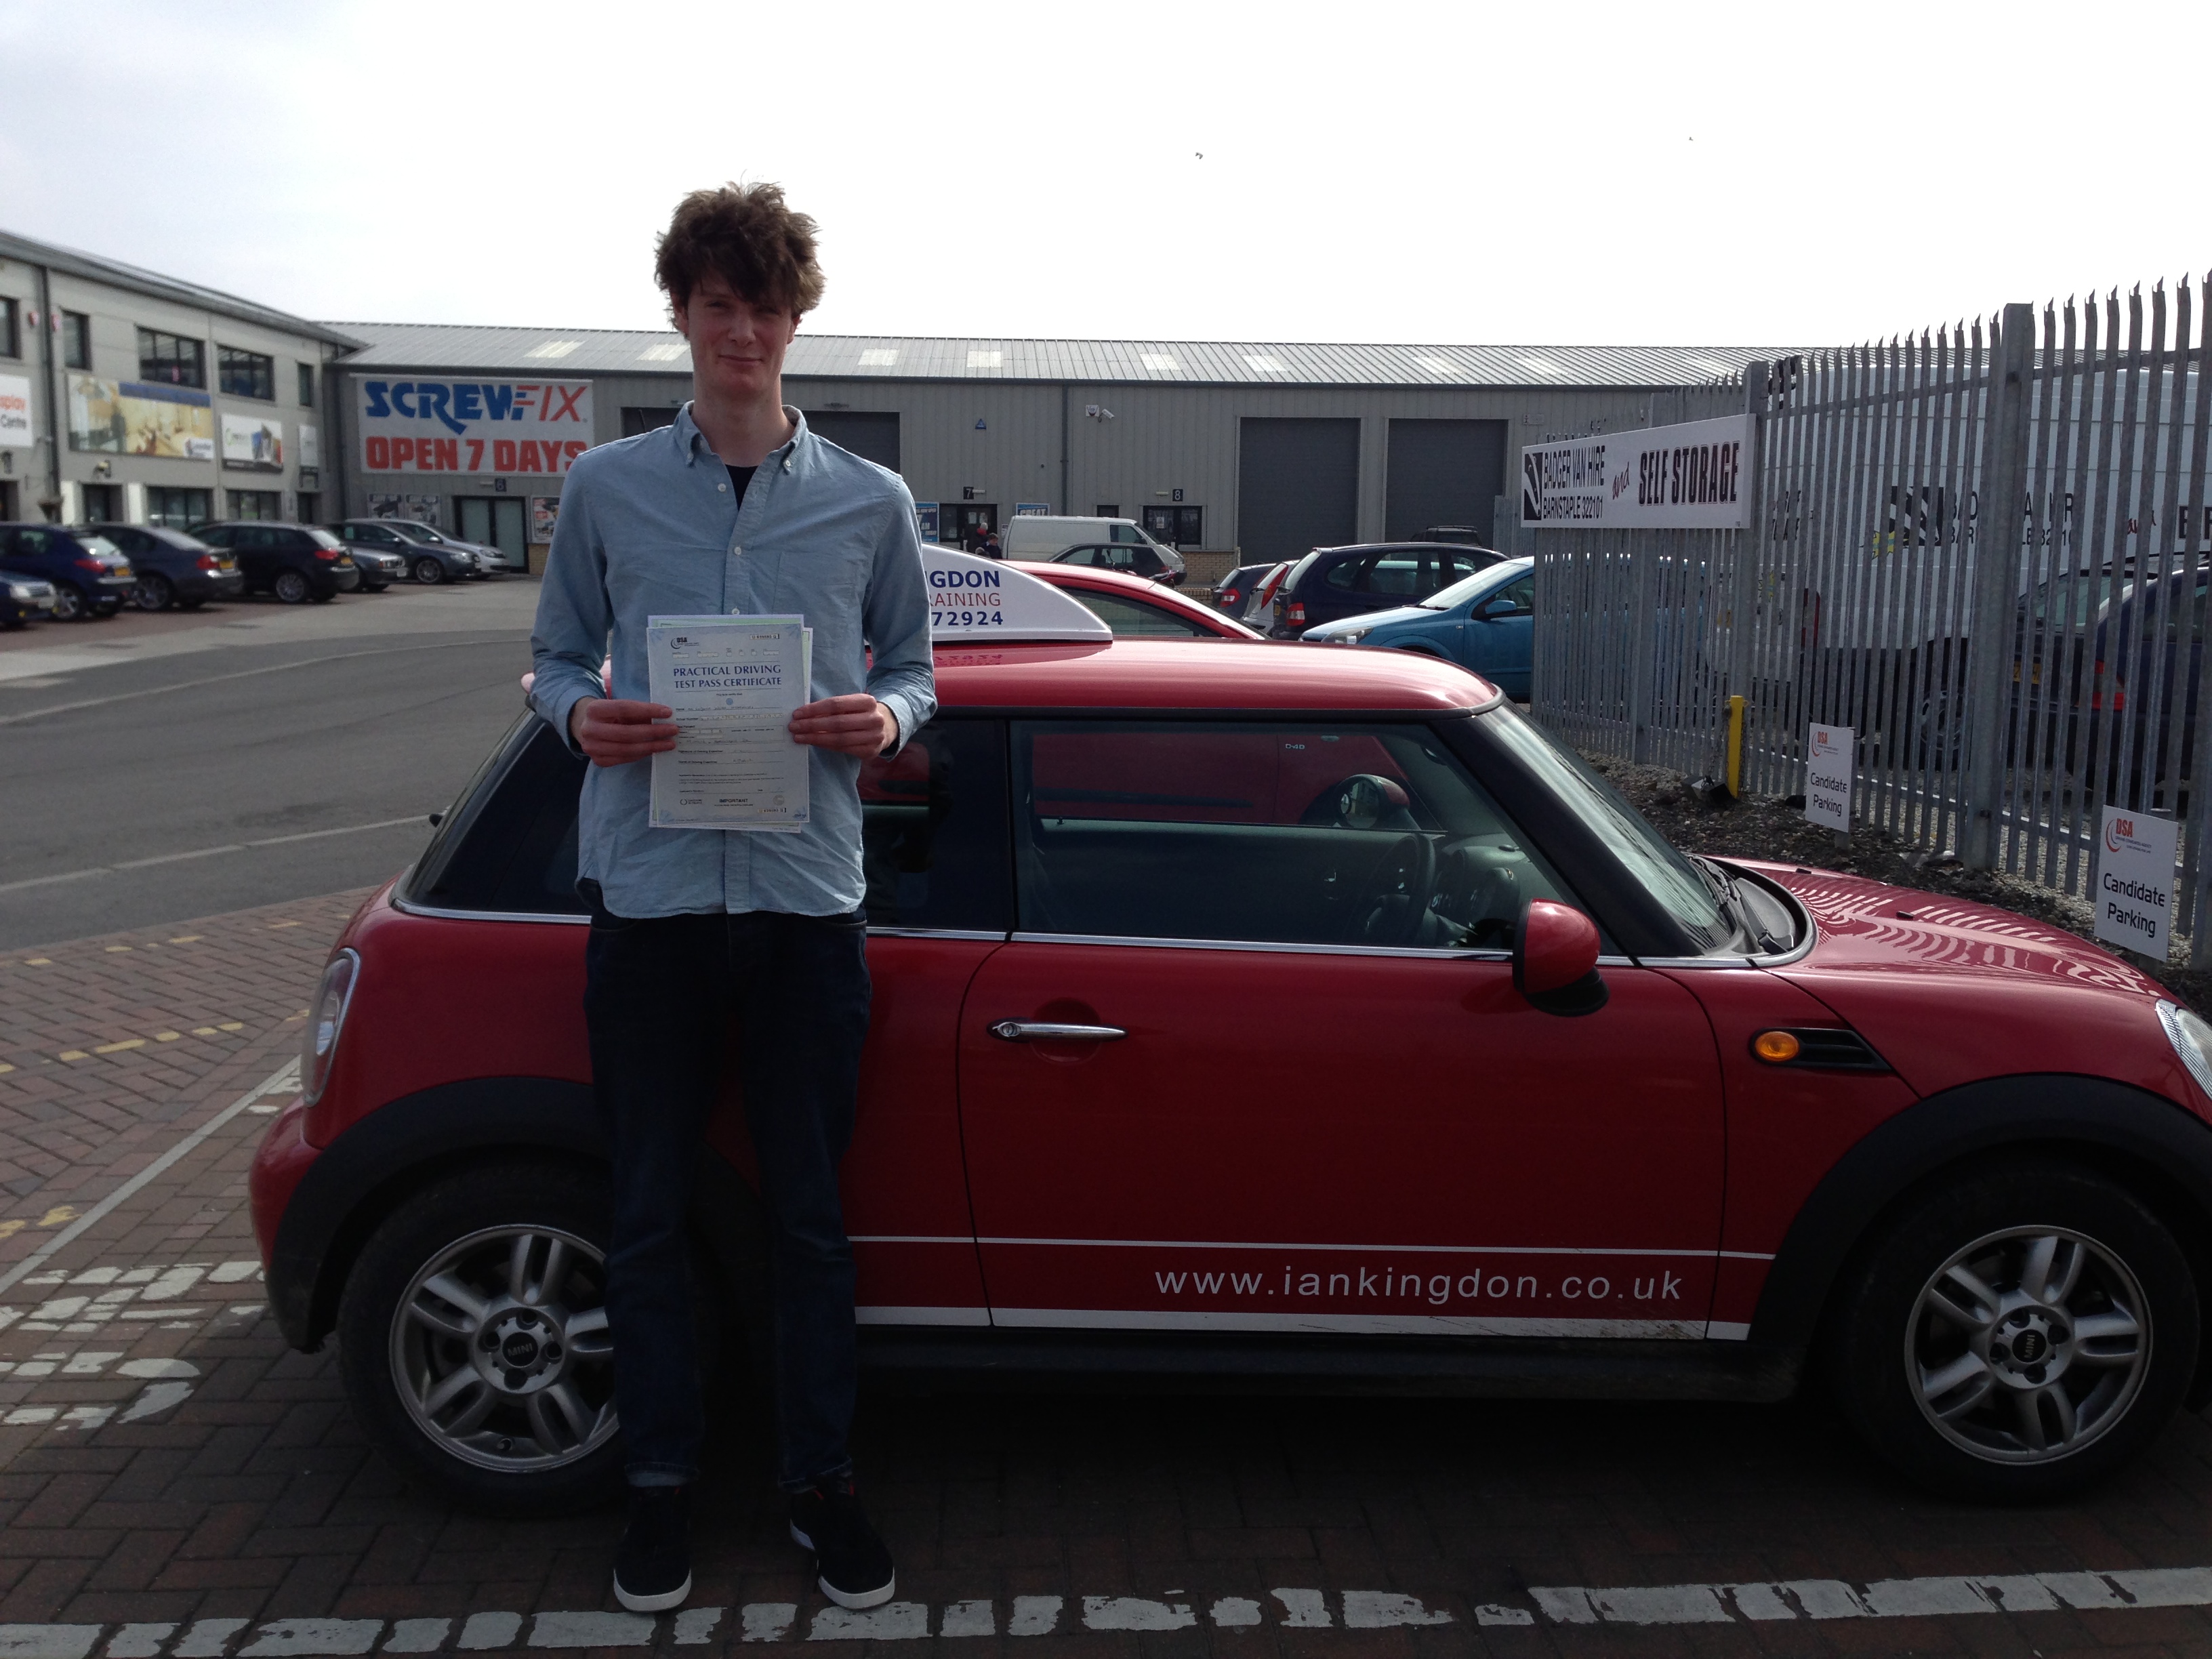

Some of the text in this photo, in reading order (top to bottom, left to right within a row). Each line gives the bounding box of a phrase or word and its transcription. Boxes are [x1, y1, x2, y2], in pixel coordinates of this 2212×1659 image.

[365, 381, 587, 435] SCREWFIX
[366, 436, 588, 472] OPEN 7 DAYS
[1543, 445, 1605, 489] BADGER VAN HIRE
[1638, 441, 1740, 506] SELF STORAGE
[1612, 462, 1630, 500] and
[966, 488, 972, 498] 7
[1174, 490, 1181, 500] 8
[1543, 495, 1603, 520] BARNSTAPLE 322101
[924, 571, 1000, 588] GDON
[674, 665, 781, 676] PRACTICAL DRIVING
[674, 678, 781, 689] TEST PASS CERTIFICATE
[1817, 731, 1828, 745] DSA
[1810, 772, 1847, 794] Candidate
[1813, 794, 1842, 817] Parking
[2116, 818, 2133, 838] DSA
[2104, 873, 2165, 907] Candidate
[2108, 902, 2156, 938] Parking
[1155, 1265, 1683, 1304] www.iankingdon.co.uk
[508, 1343, 533, 1357] MINI
